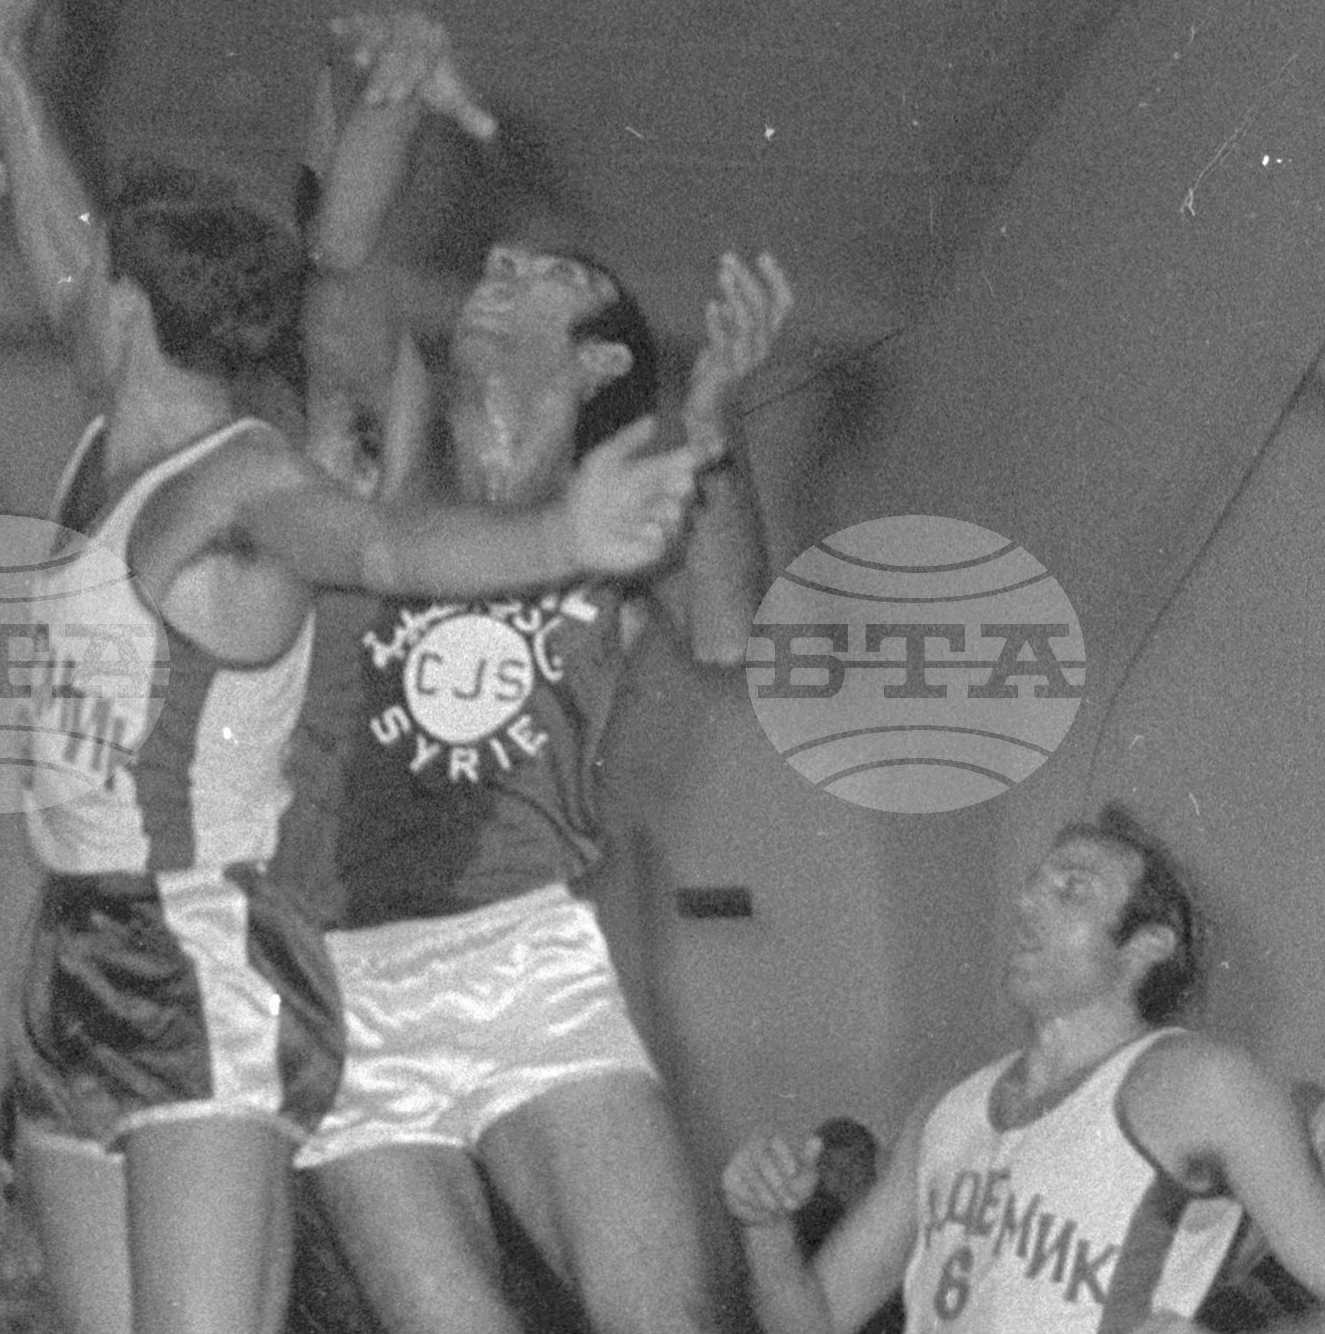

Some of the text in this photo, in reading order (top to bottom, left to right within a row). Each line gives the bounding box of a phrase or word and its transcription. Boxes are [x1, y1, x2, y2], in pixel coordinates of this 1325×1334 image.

[416, 650, 527, 702] CJS
[370, 705, 549, 782] SYRIE
[933, 1246, 974, 1321] 6
